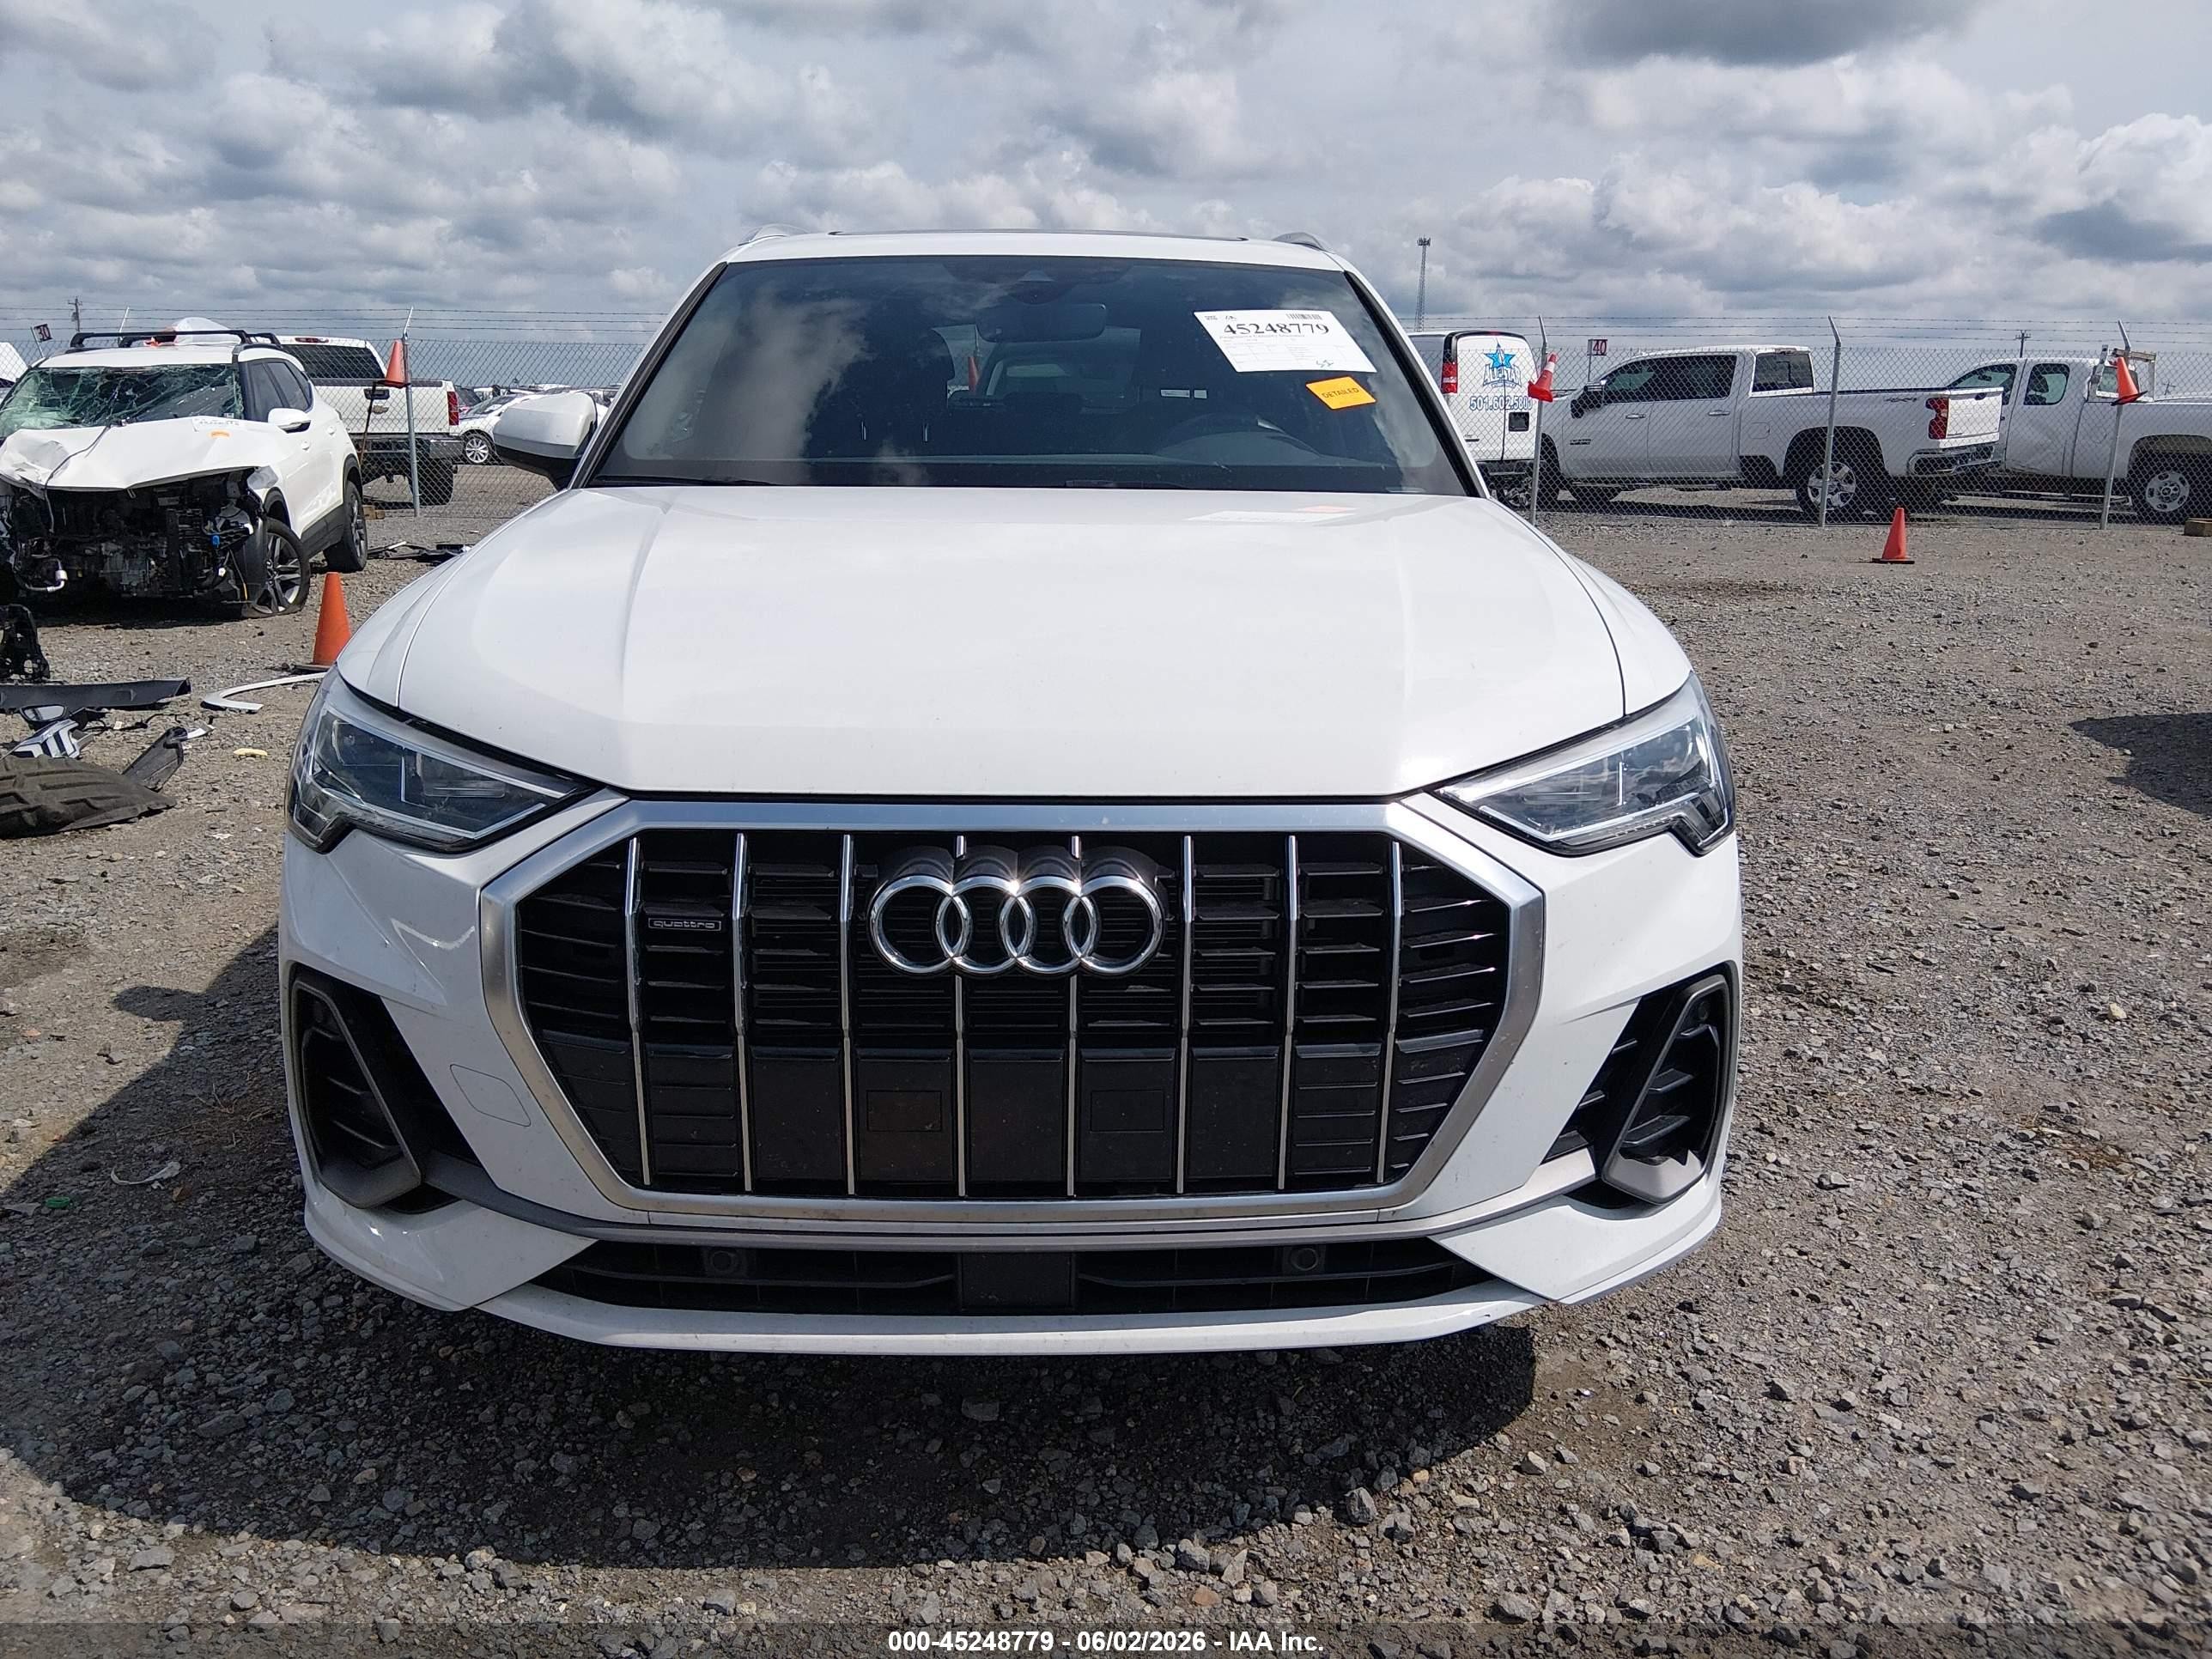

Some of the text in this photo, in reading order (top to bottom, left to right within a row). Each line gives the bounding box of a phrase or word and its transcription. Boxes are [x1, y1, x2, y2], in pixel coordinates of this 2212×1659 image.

[36, 325, 51, 341] 30
[1224, 323, 1329, 335] 45248779
[1593, 339, 1607, 356] 40
[1321, 388, 1359, 398] DETAILED
